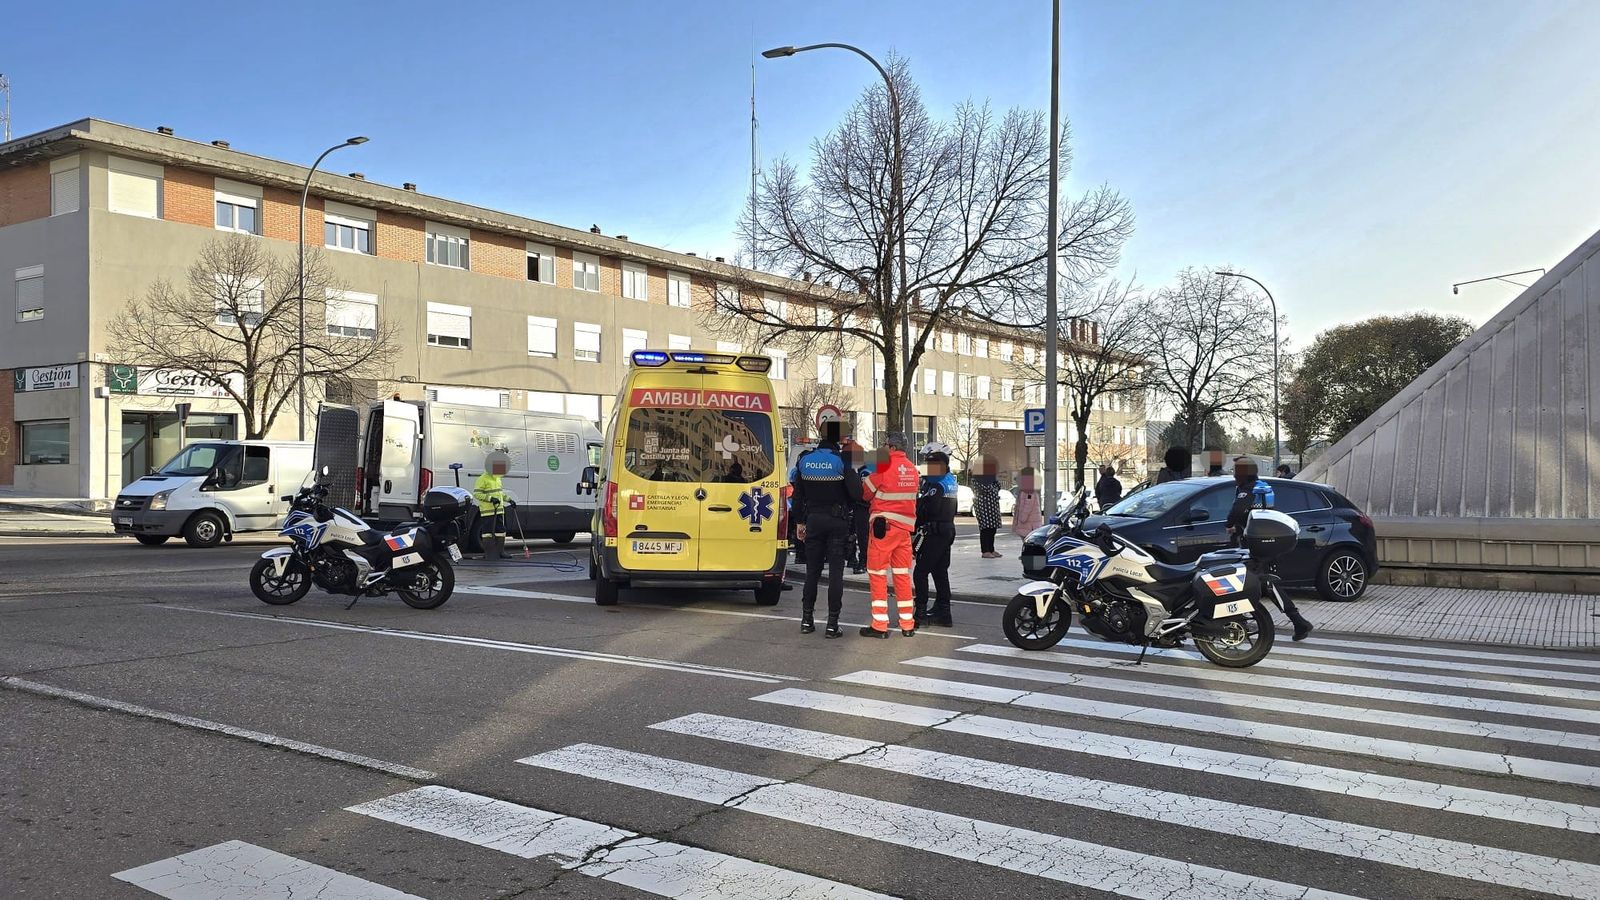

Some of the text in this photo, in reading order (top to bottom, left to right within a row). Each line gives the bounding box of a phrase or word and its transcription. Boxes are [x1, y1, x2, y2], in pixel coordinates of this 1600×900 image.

[640, 391, 763, 409] AMBULANCIA
[1029, 411, 1045, 432] P
[741, 444, 762, 454] Sacyl
[638, 542, 682, 551] 8445 MFJ
[1066, 559, 1082, 567] 112
